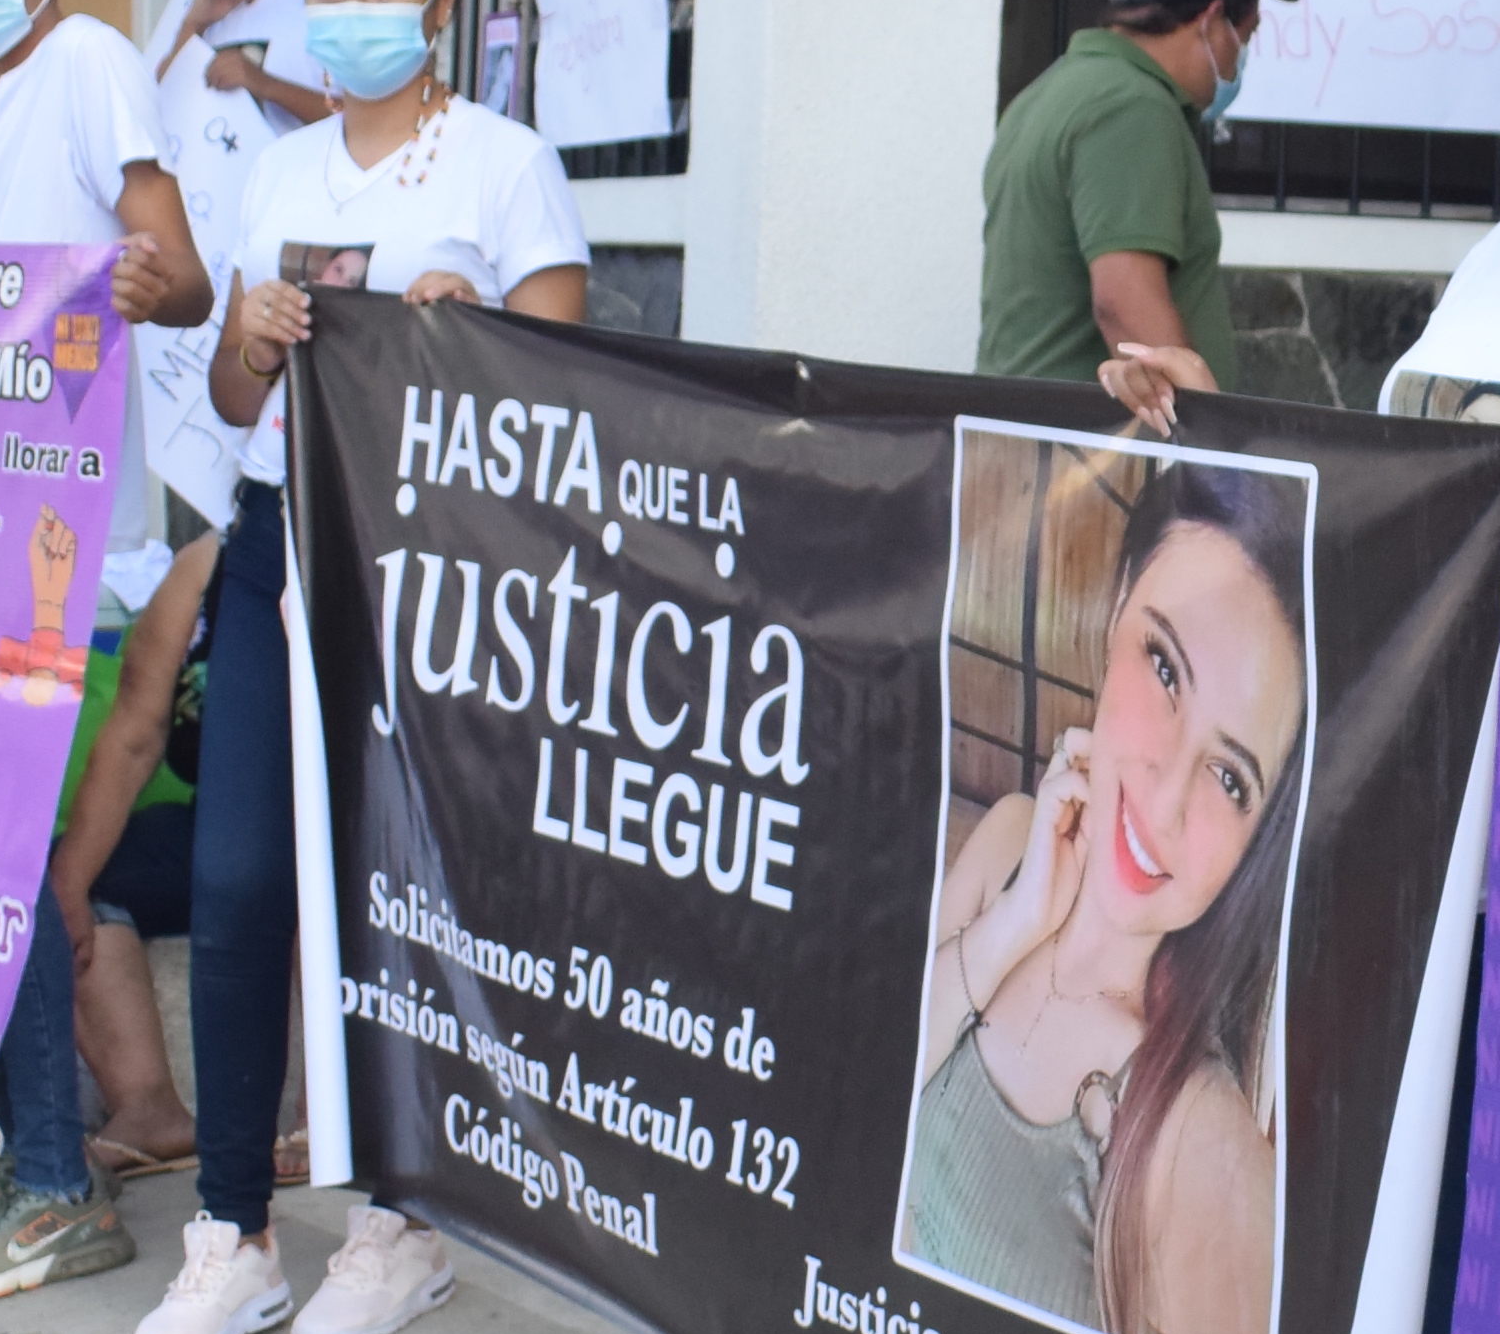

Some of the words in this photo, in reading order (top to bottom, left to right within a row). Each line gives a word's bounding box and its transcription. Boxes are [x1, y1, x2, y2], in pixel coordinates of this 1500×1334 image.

[2, 431, 71, 477] llorar
[77, 446, 103, 480] a
[397, 385, 604, 515] HASTA
[618, 463, 690, 525] QUE
[698, 475, 746, 536] LA
[371, 481, 811, 785] justicia
[531, 735, 801, 912] LLEGUE
[367, 870, 556, 1001] Solicitamos
[562, 943, 613, 1020] 50
[619, 966, 715, 1048] años
[723, 1012, 776, 1081] de
[442, 1090, 561, 1213] Código
[560, 1160, 660, 1257] Penal
[465, 1023, 553, 1113] según
[556, 1049, 713, 1174] Artículo
[725, 1126, 801, 1211] 132
